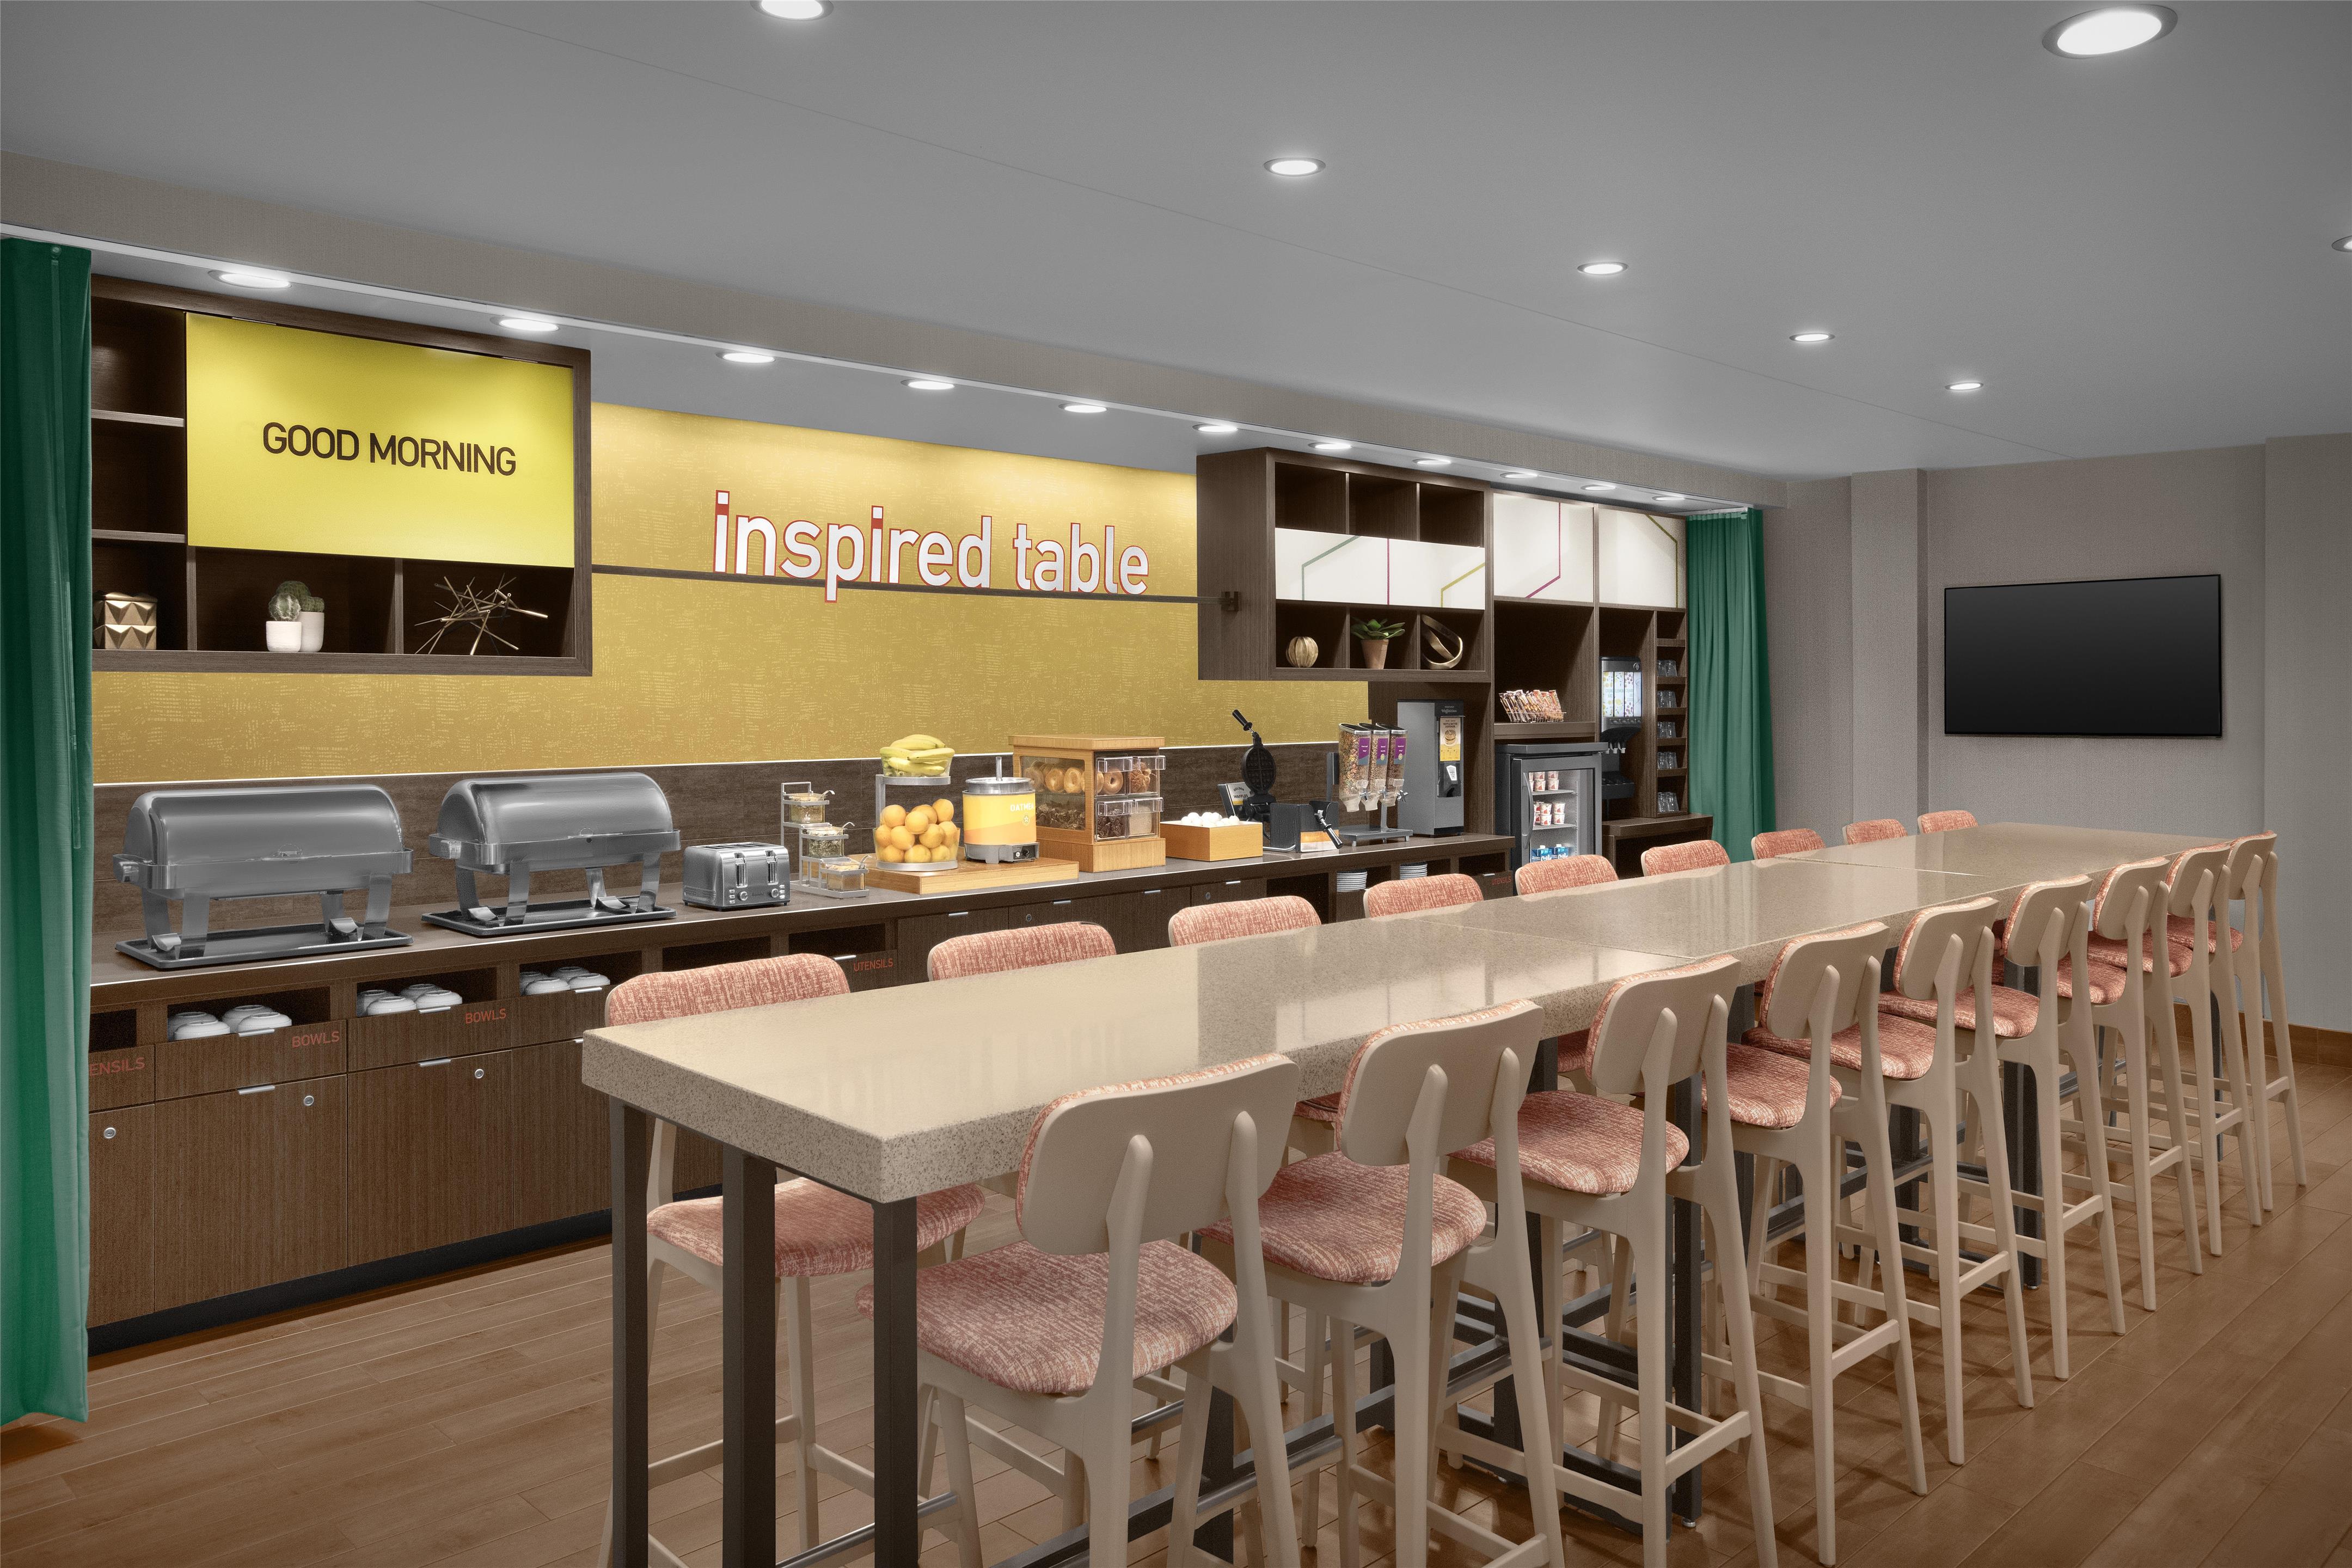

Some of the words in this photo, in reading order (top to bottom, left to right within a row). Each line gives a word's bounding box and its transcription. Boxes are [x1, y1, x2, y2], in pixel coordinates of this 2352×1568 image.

[263, 422, 359, 461] GOOD
[370, 433, 516, 476] MORNING
[714, 489, 993, 603] inspired
[1012, 523, 1149, 595] table
[1491, 876, 1511, 885] UTENSILS
[853, 958, 893, 972] UTENSILS
[465, 1007, 507, 1024] BOWLS
[292, 1031, 340, 1048] BOWLS
